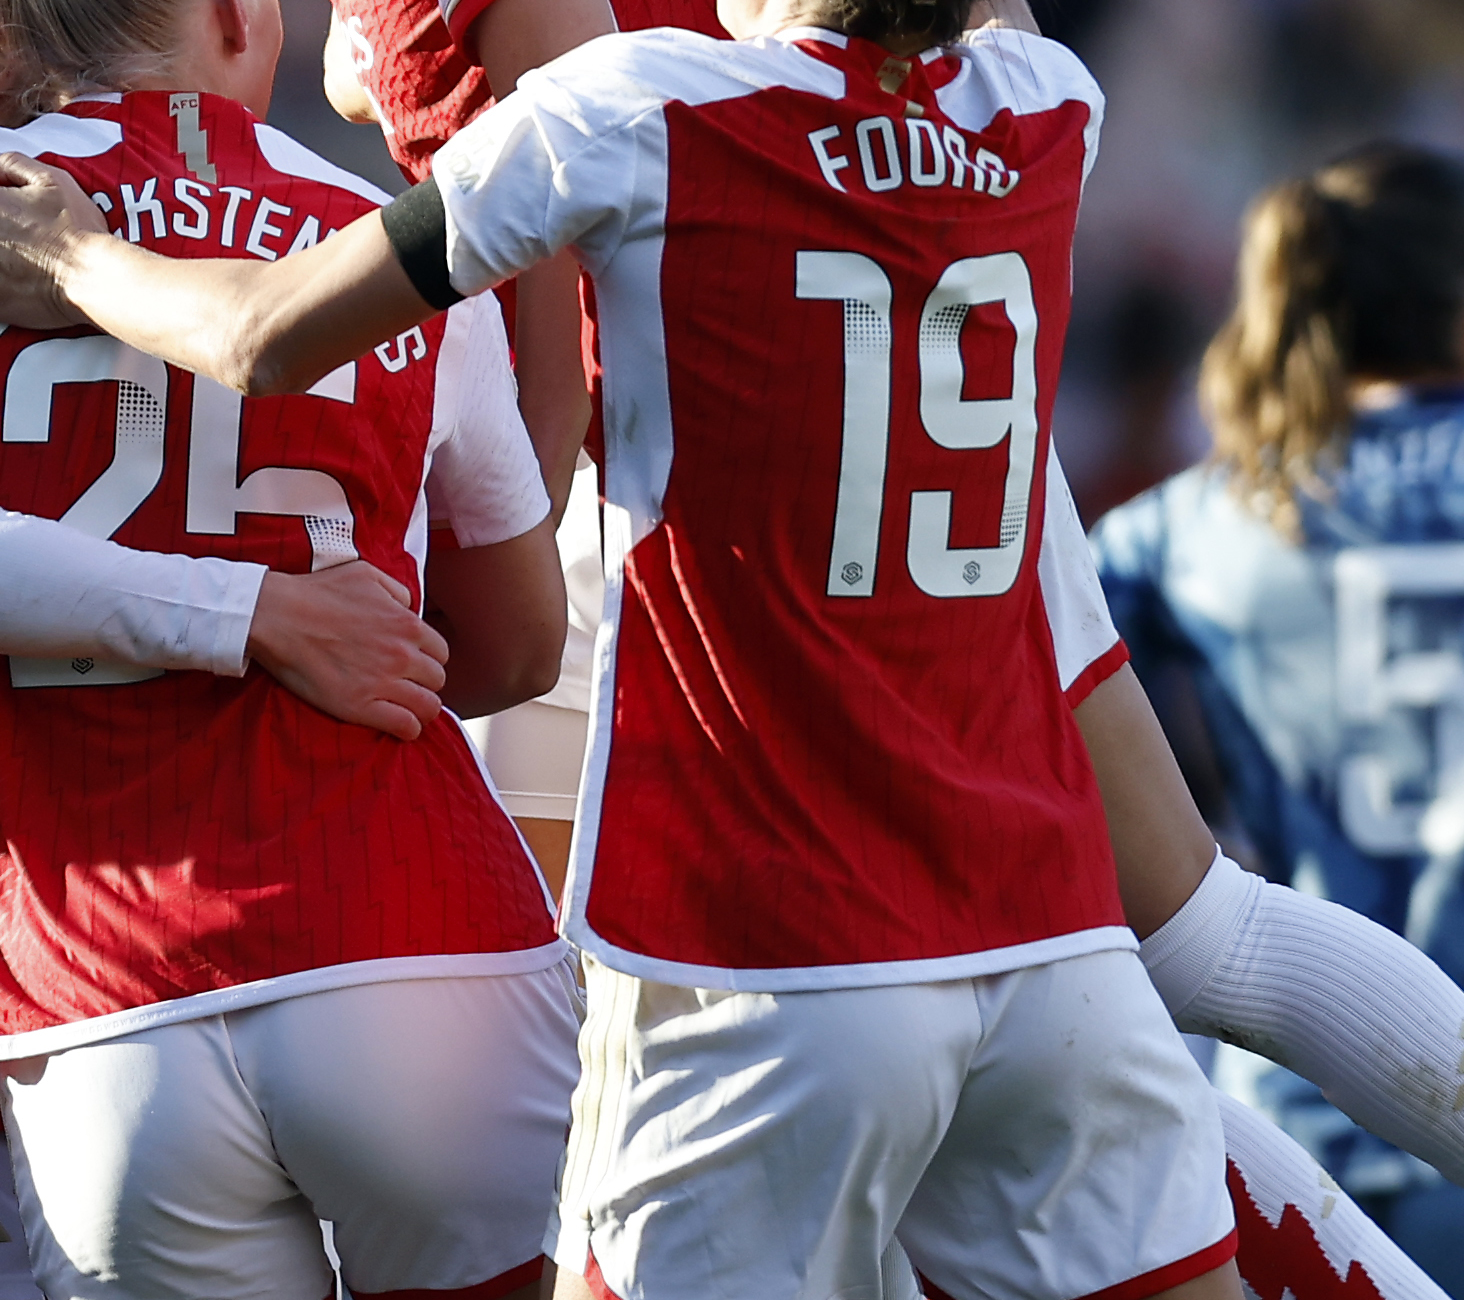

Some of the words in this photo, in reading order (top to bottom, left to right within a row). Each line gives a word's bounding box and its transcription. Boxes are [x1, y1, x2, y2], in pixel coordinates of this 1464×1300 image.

[171, 98, 198, 111] AFC
[2, 335, 360, 689] 25
[795, 249, 1039, 599] 19
